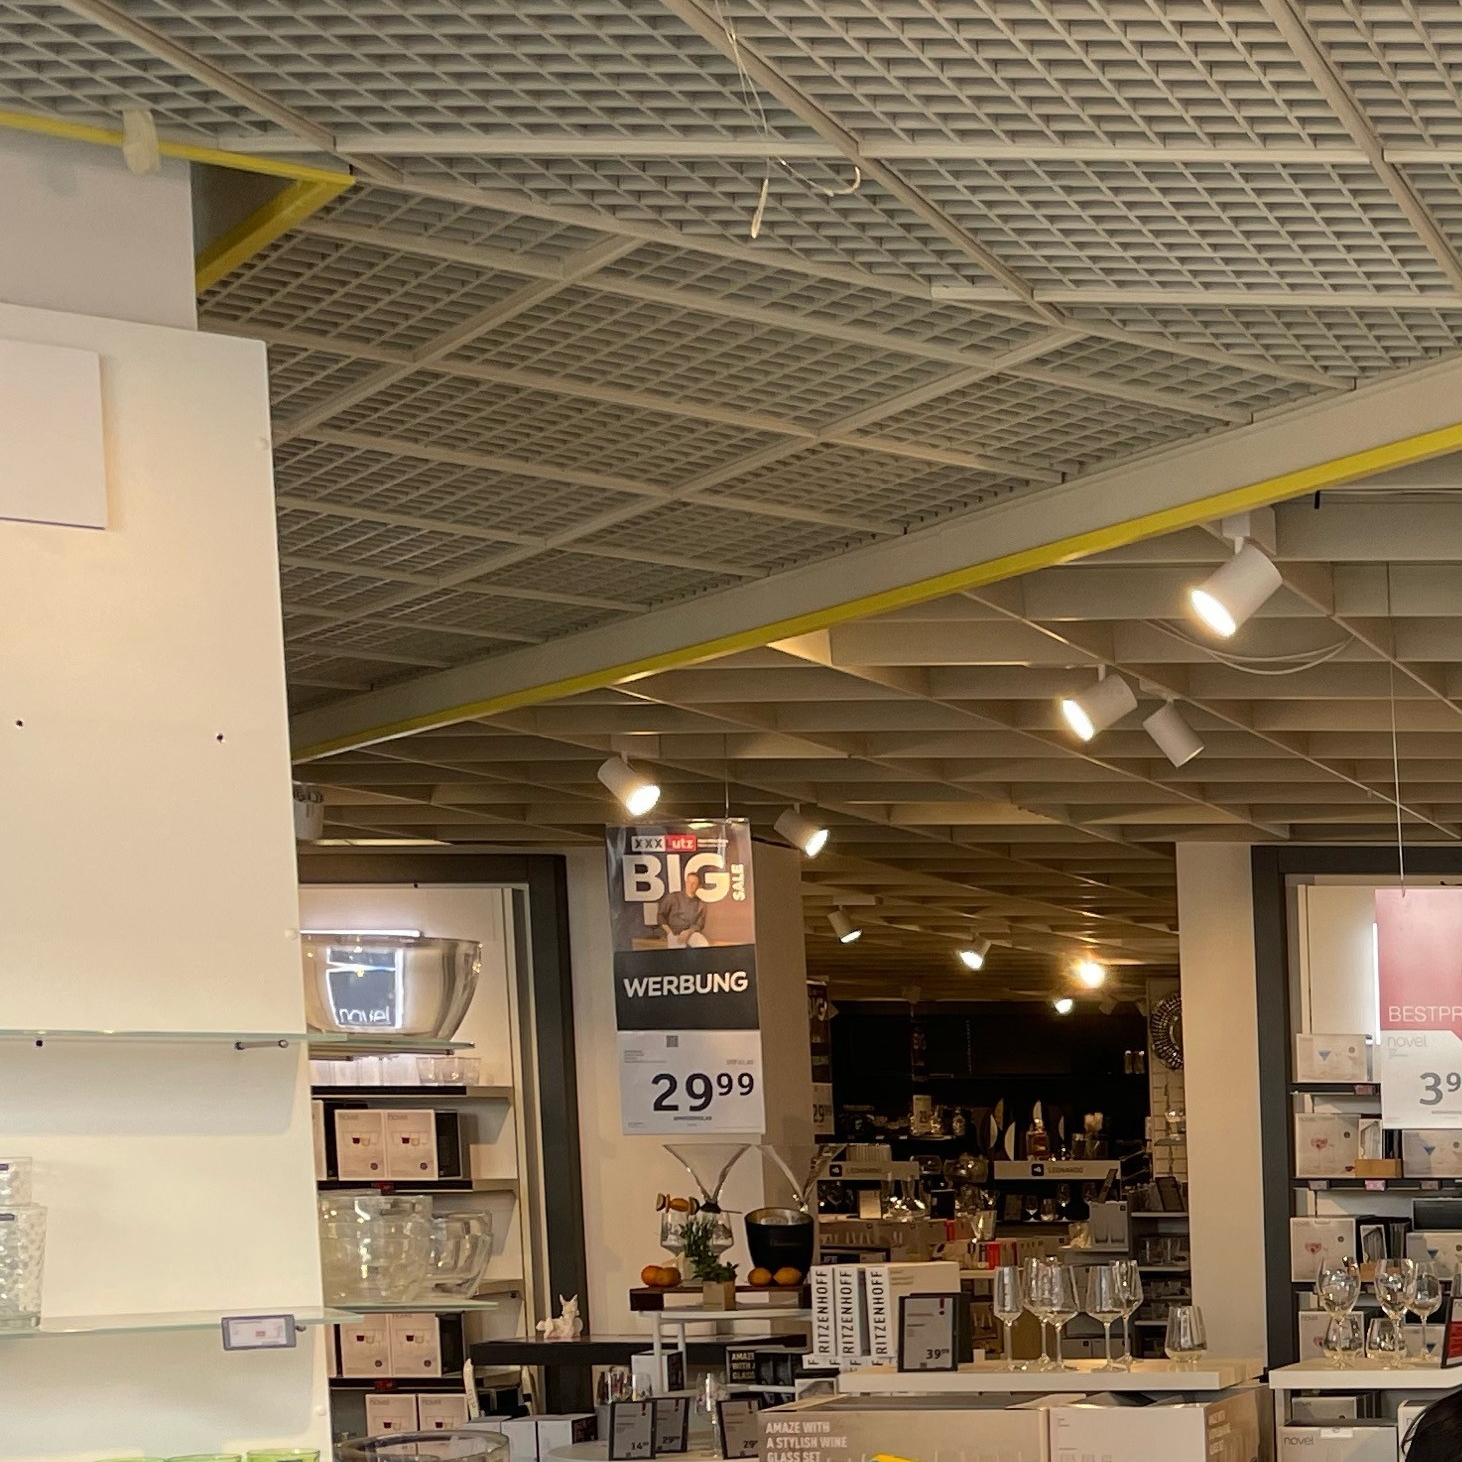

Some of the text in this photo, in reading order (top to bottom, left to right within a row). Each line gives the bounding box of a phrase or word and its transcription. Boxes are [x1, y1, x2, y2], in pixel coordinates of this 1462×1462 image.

[623, 853, 731, 902] BIG
[731, 864, 746, 901] SALE
[623, 971, 749, 998] WERBUNG
[1387, 1034, 1428, 1048] novel
[815, 1270, 830, 1354] RITZENHOFF
[839, 1270, 854, 1355] RITZENHOFF
[870, 1270, 888, 1355] RITZENHOFF
[766, 1421, 830, 1434] AMAZE WITH
[1283, 1435, 1314, 1446] novel
[766, 1436, 848, 1449] A STYLISH WINE
[802, 1451, 821, 1462] SET
